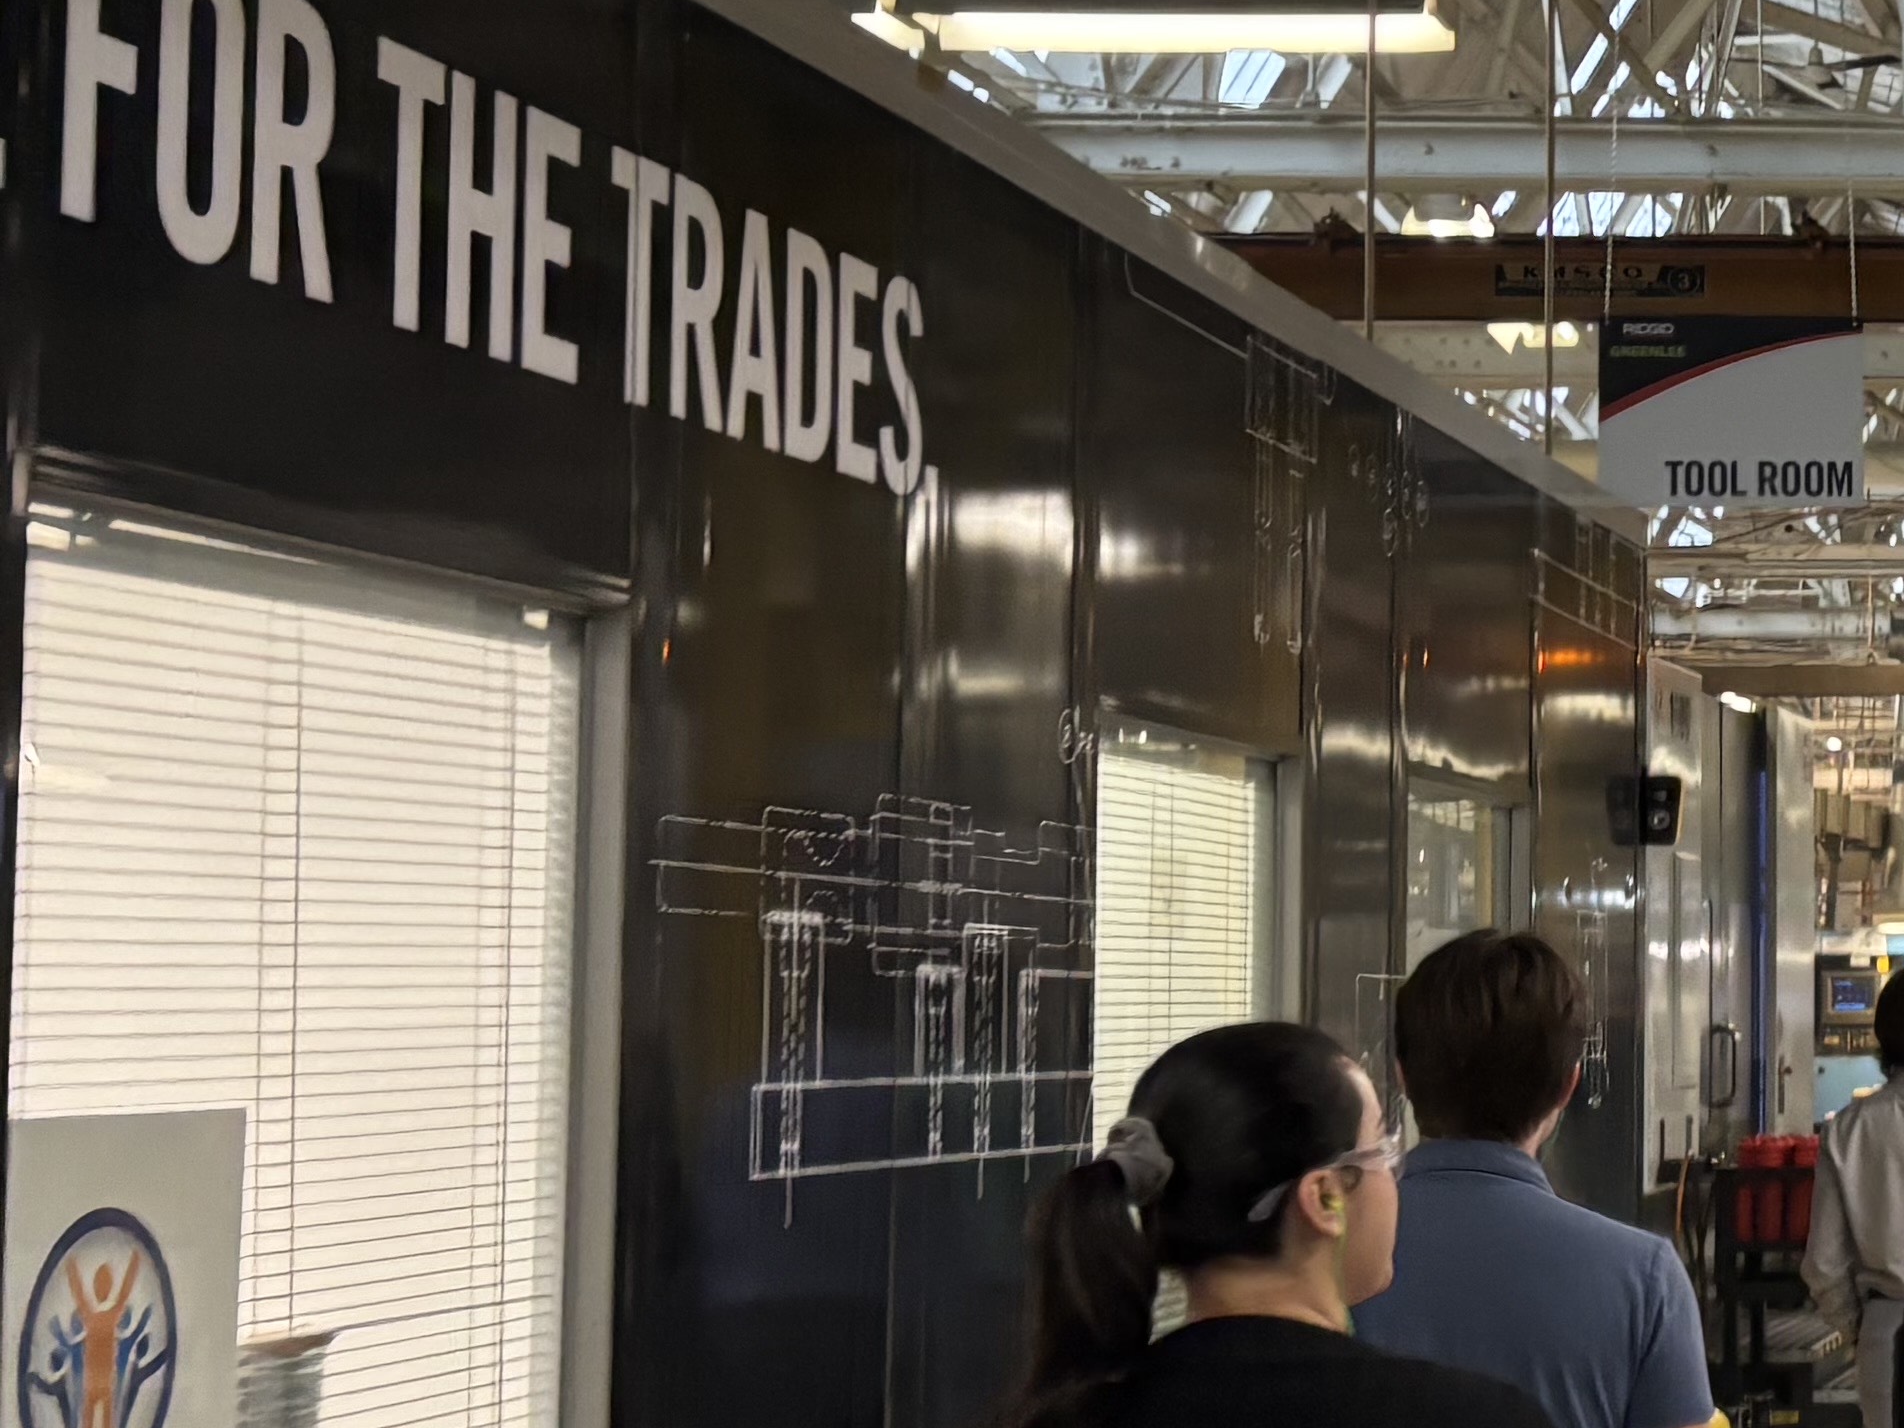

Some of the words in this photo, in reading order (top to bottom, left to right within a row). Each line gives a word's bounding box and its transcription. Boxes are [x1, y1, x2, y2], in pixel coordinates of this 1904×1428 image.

[377, 35, 582, 385] THE
[1664, 460, 1747, 498] TOOL
[1757, 460, 1854, 498] ROOM
